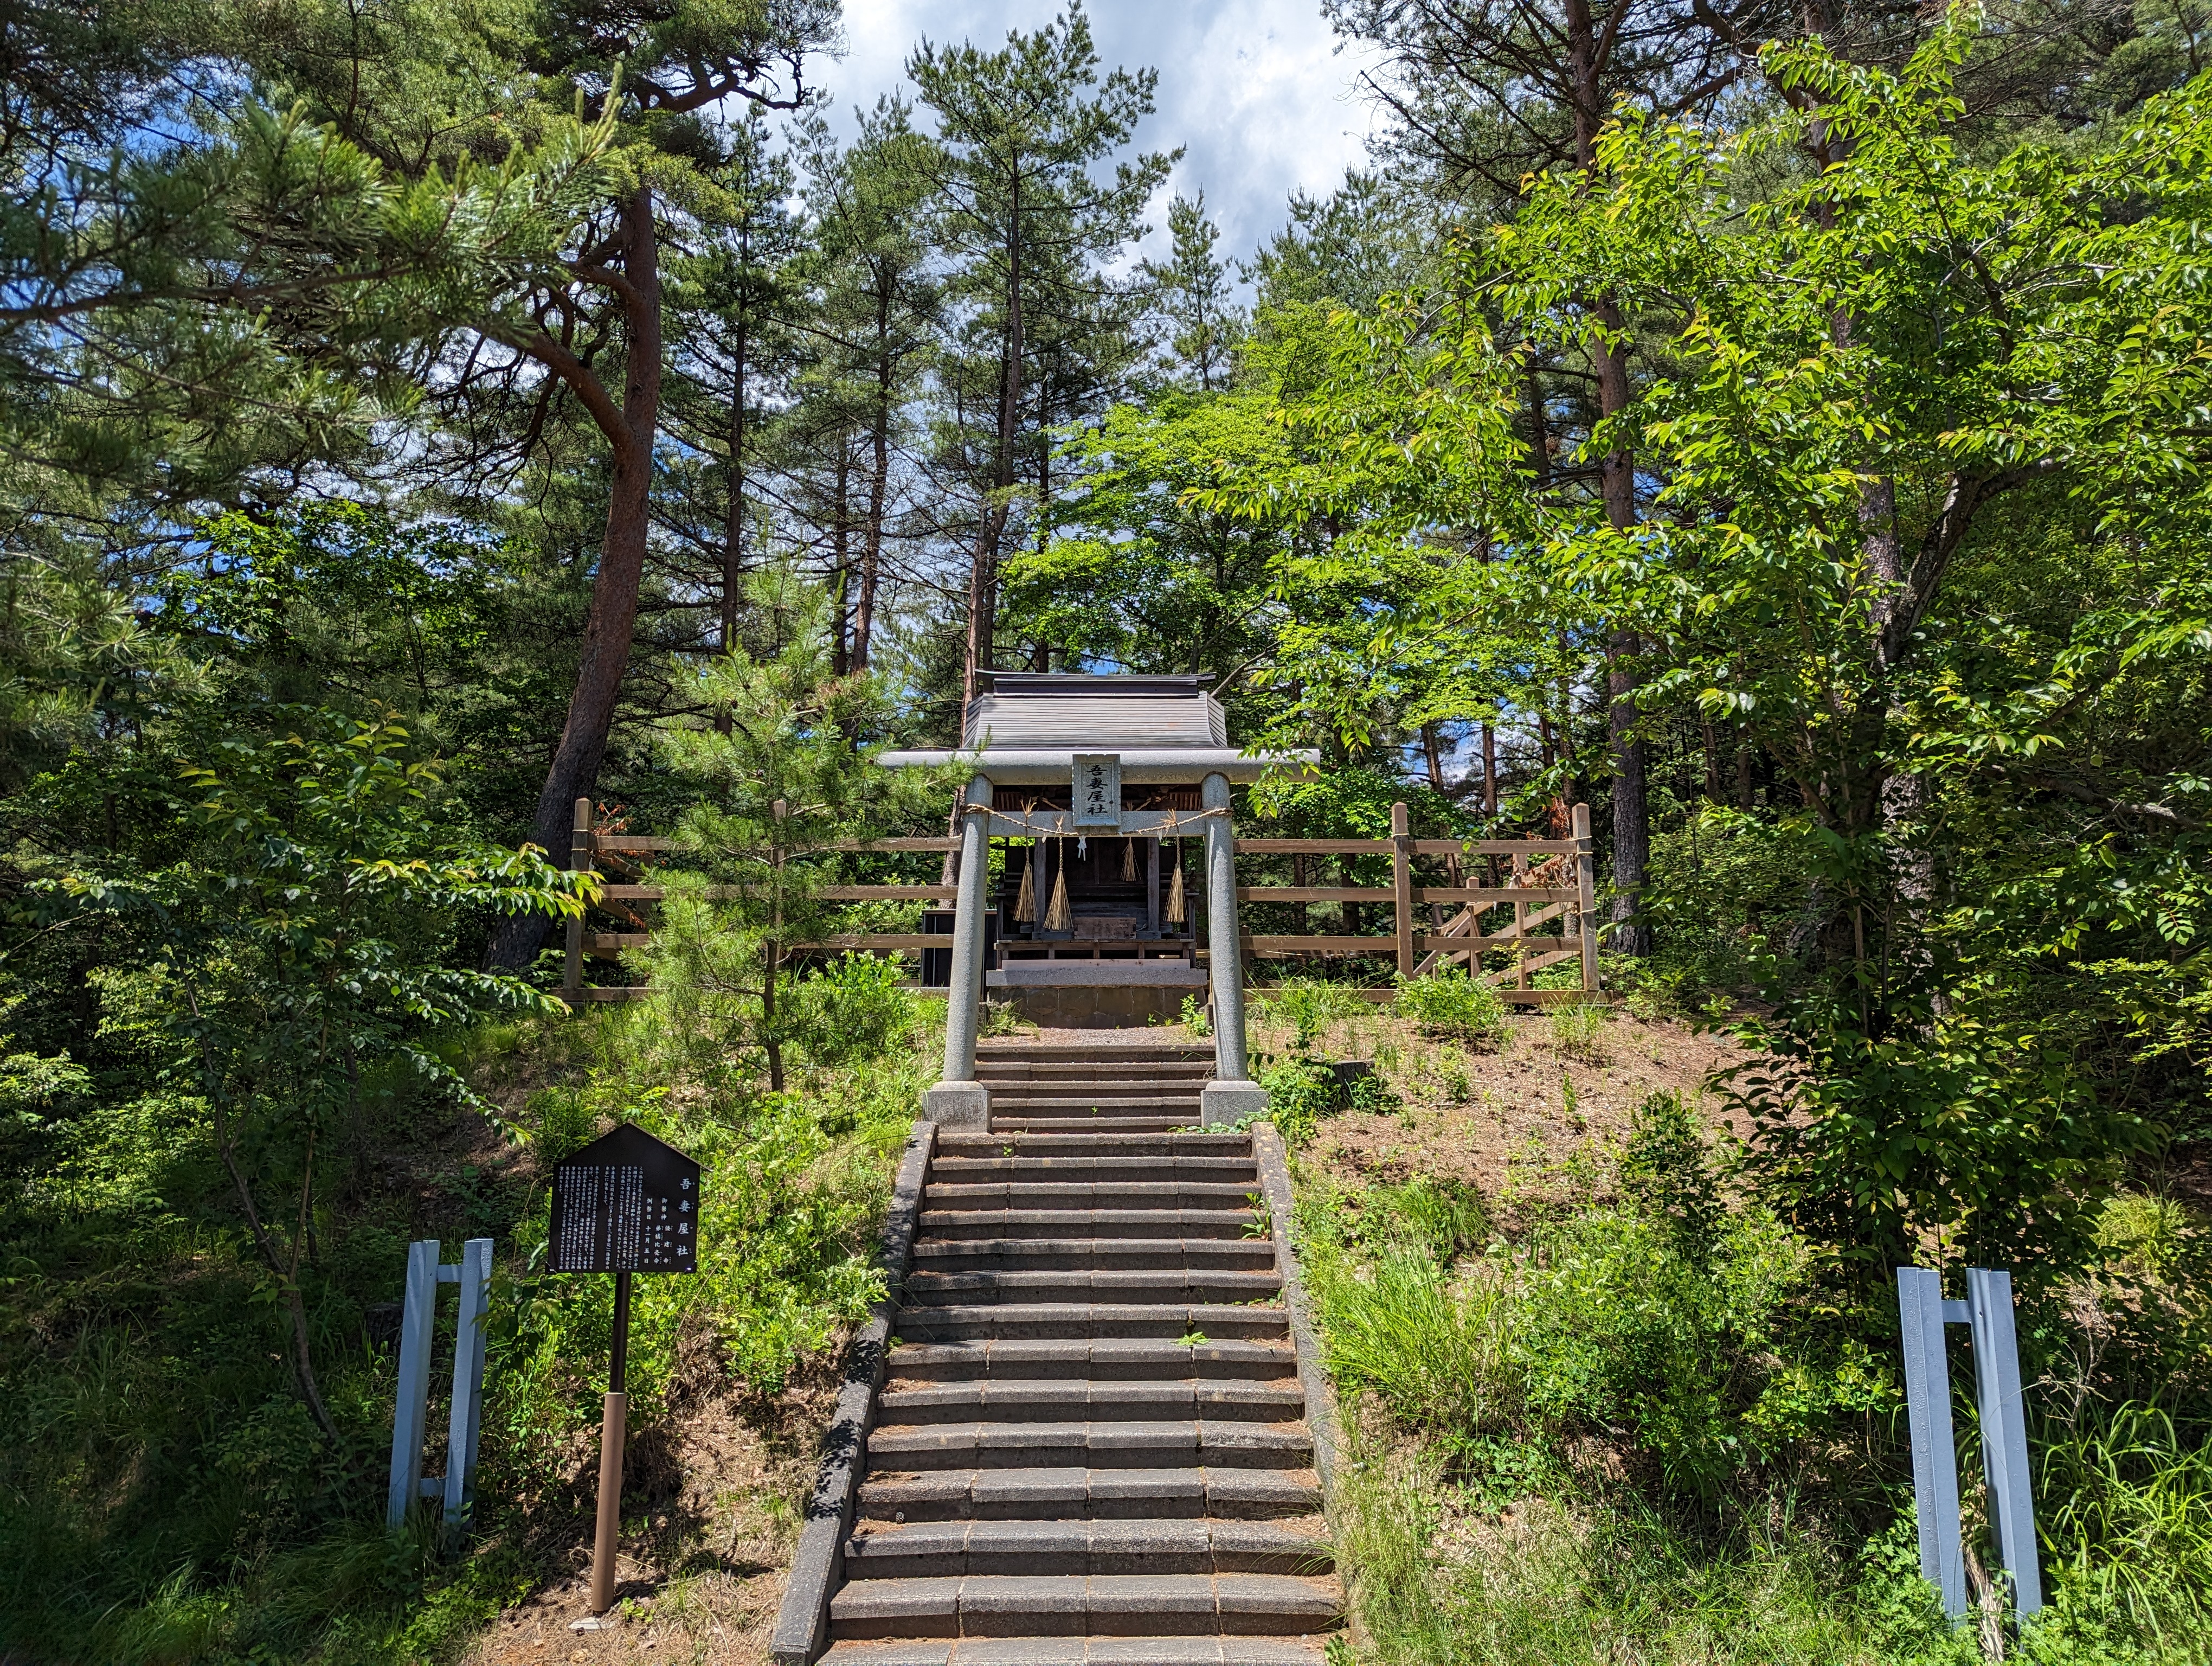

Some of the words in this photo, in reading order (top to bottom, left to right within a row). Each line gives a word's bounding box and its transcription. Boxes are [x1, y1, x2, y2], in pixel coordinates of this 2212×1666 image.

[1086, 765, 1108, 815] 吾妻屋社
[676, 1178, 692, 1257] 吾妻屋社
